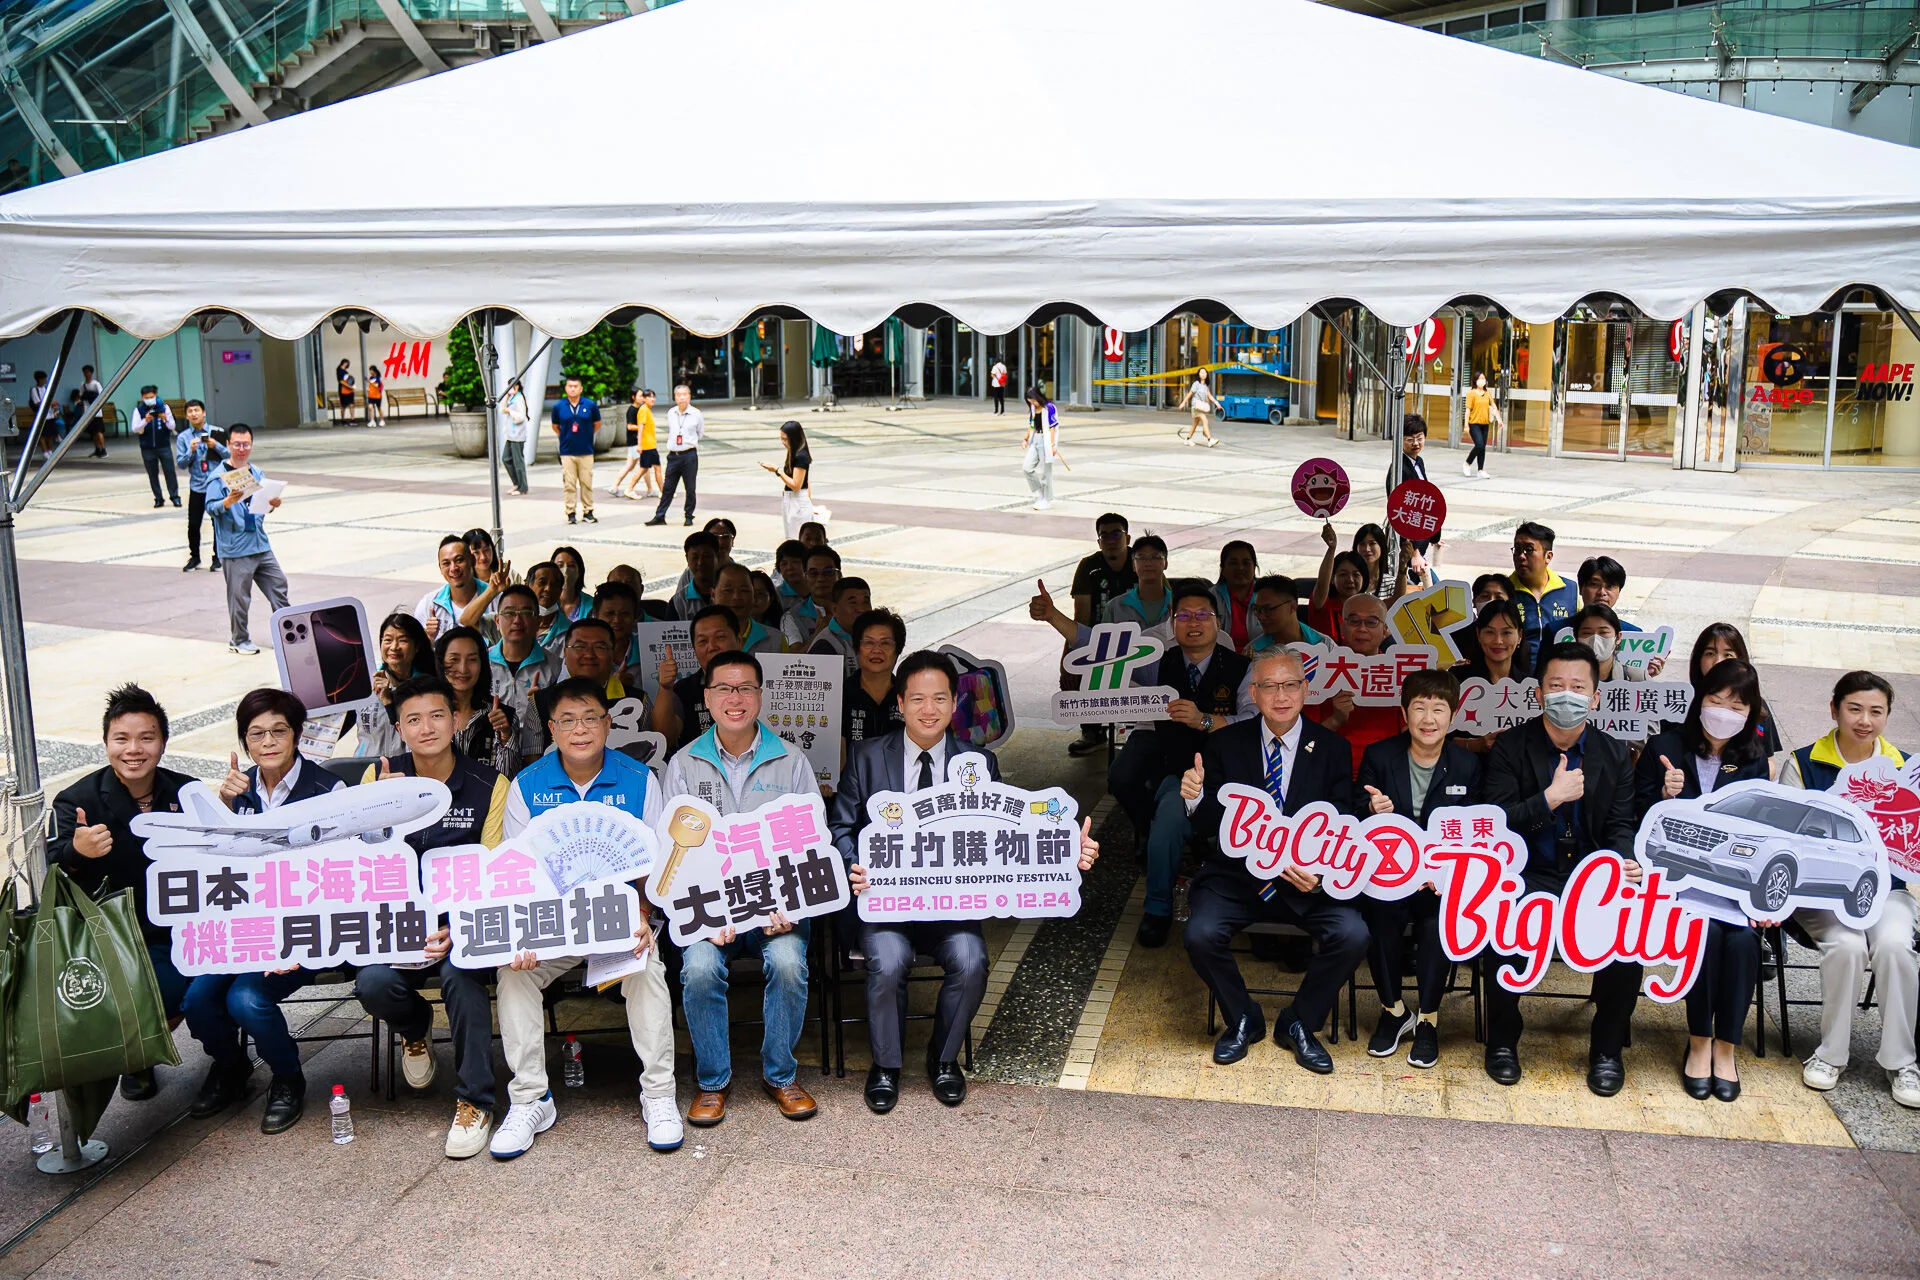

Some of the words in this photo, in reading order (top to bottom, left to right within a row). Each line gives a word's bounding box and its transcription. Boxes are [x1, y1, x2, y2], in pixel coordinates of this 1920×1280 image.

[383, 341, 431, 379] H&M
[1860, 363, 1915, 382] AAPE
[1751, 385, 1814, 408] Aape
[1857, 383, 1914, 401] NOW!
[1403, 490, 1436, 512] 新竹
[1391, 507, 1439, 532] 大遠百
[649, 643, 694, 653] 電子票證明
[765, 680, 832, 691] 電子發票證明聯
[1323, 654, 1429, 698] 大遠百
[770, 691, 825, 702] 113年11-12月
[770, 702, 824, 711] HC-11311121
[1059, 694, 1171, 709] 新竹市旅館商業同業公會
[1495, 686, 1687, 714] 大魯雅廣場
[533, 793, 562, 803] KMT
[602, 794, 626, 806] 議員
[912, 792, 1026, 820] 百萬抽好禮
[1441, 818, 1494, 840] 遠東
[712, 804, 821, 877] 汽車
[869, 829, 1071, 868] 新竹購物節
[158, 852, 409, 915] 日本北海道
[431, 849, 538, 905] 現金
[870, 876, 897, 886] 2024
[899, 876, 952, 886] HSINCHU
[955, 874, 1013, 884] SHOPPING
[1017, 872, 1072, 883] FESTIVAL
[674, 849, 839, 936] 大獎抽
[868, 895, 987, 912] 2024.10.25
[1016, 892, 1070, 908] 12.24
[460, 884, 631, 958] 週週抽
[181, 902, 427, 967] 機票月月抽
